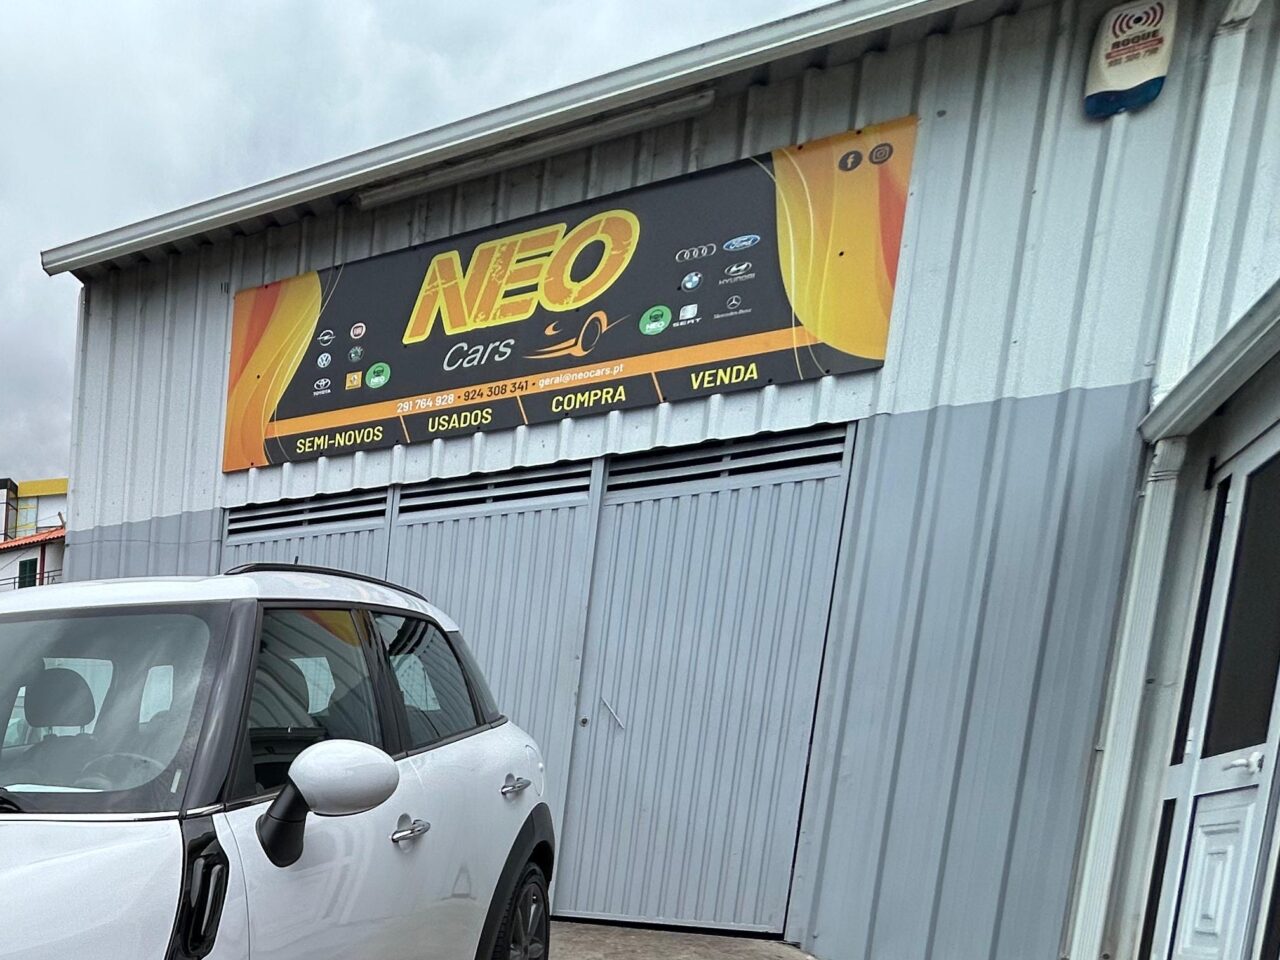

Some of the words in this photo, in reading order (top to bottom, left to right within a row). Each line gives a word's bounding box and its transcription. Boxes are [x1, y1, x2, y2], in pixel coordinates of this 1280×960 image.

[402, 209, 640, 345] NEO
[672, 318, 702, 327] SEAT
[442, 338, 515, 372] Cars
[397, 402, 413, 413] 291
[435, 393, 455, 406] 928
[463, 388, 484, 401] 924
[486, 384, 507, 397] 308
[509, 380, 529, 393] 341
[538, 363, 624, 388] geral@neocars.pt
[690, 362, 758, 390] VENDA
[551, 385, 626, 413] COMPRA
[428, 408, 492, 432] USADOS
[296, 425, 384, 453] SEMI-NOVOS
